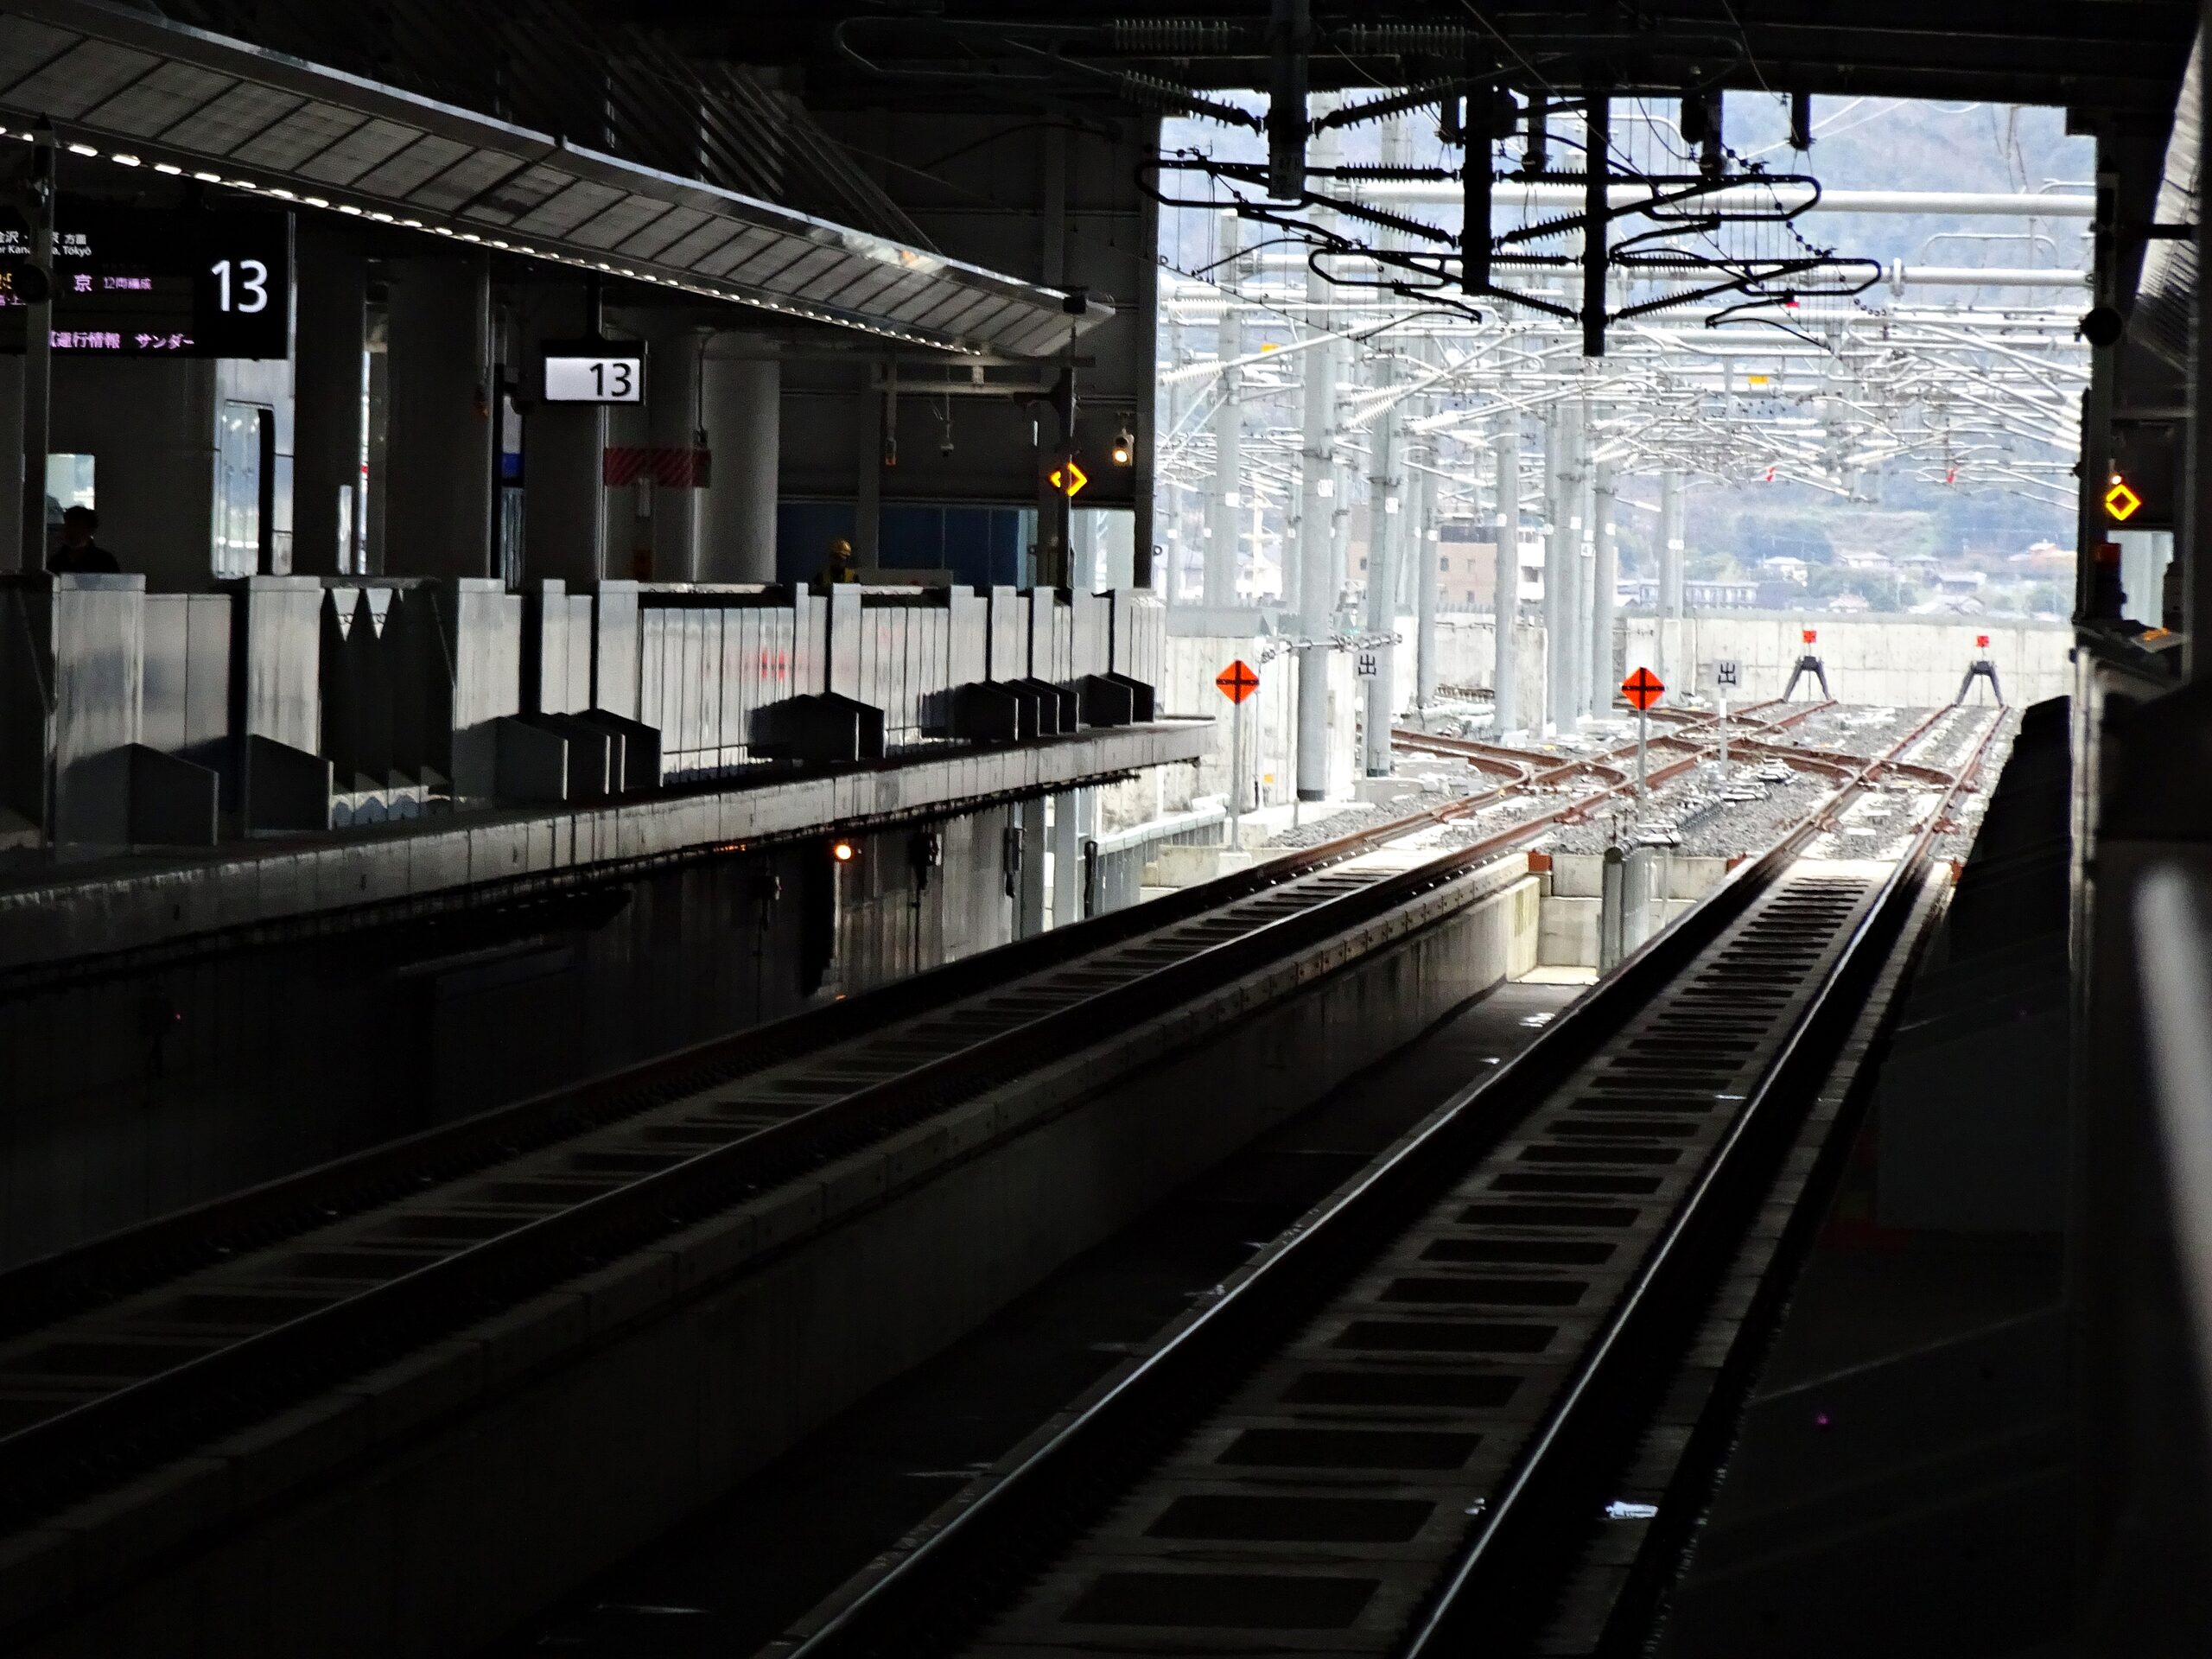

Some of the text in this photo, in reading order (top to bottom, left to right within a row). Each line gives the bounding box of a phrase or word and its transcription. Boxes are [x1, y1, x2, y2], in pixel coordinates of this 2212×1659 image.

[210, 258, 269, 314] 13
[589, 363, 632, 397] 13
[1357, 654, 1376, 677] 出
[1718, 662, 1736, 686] 出
